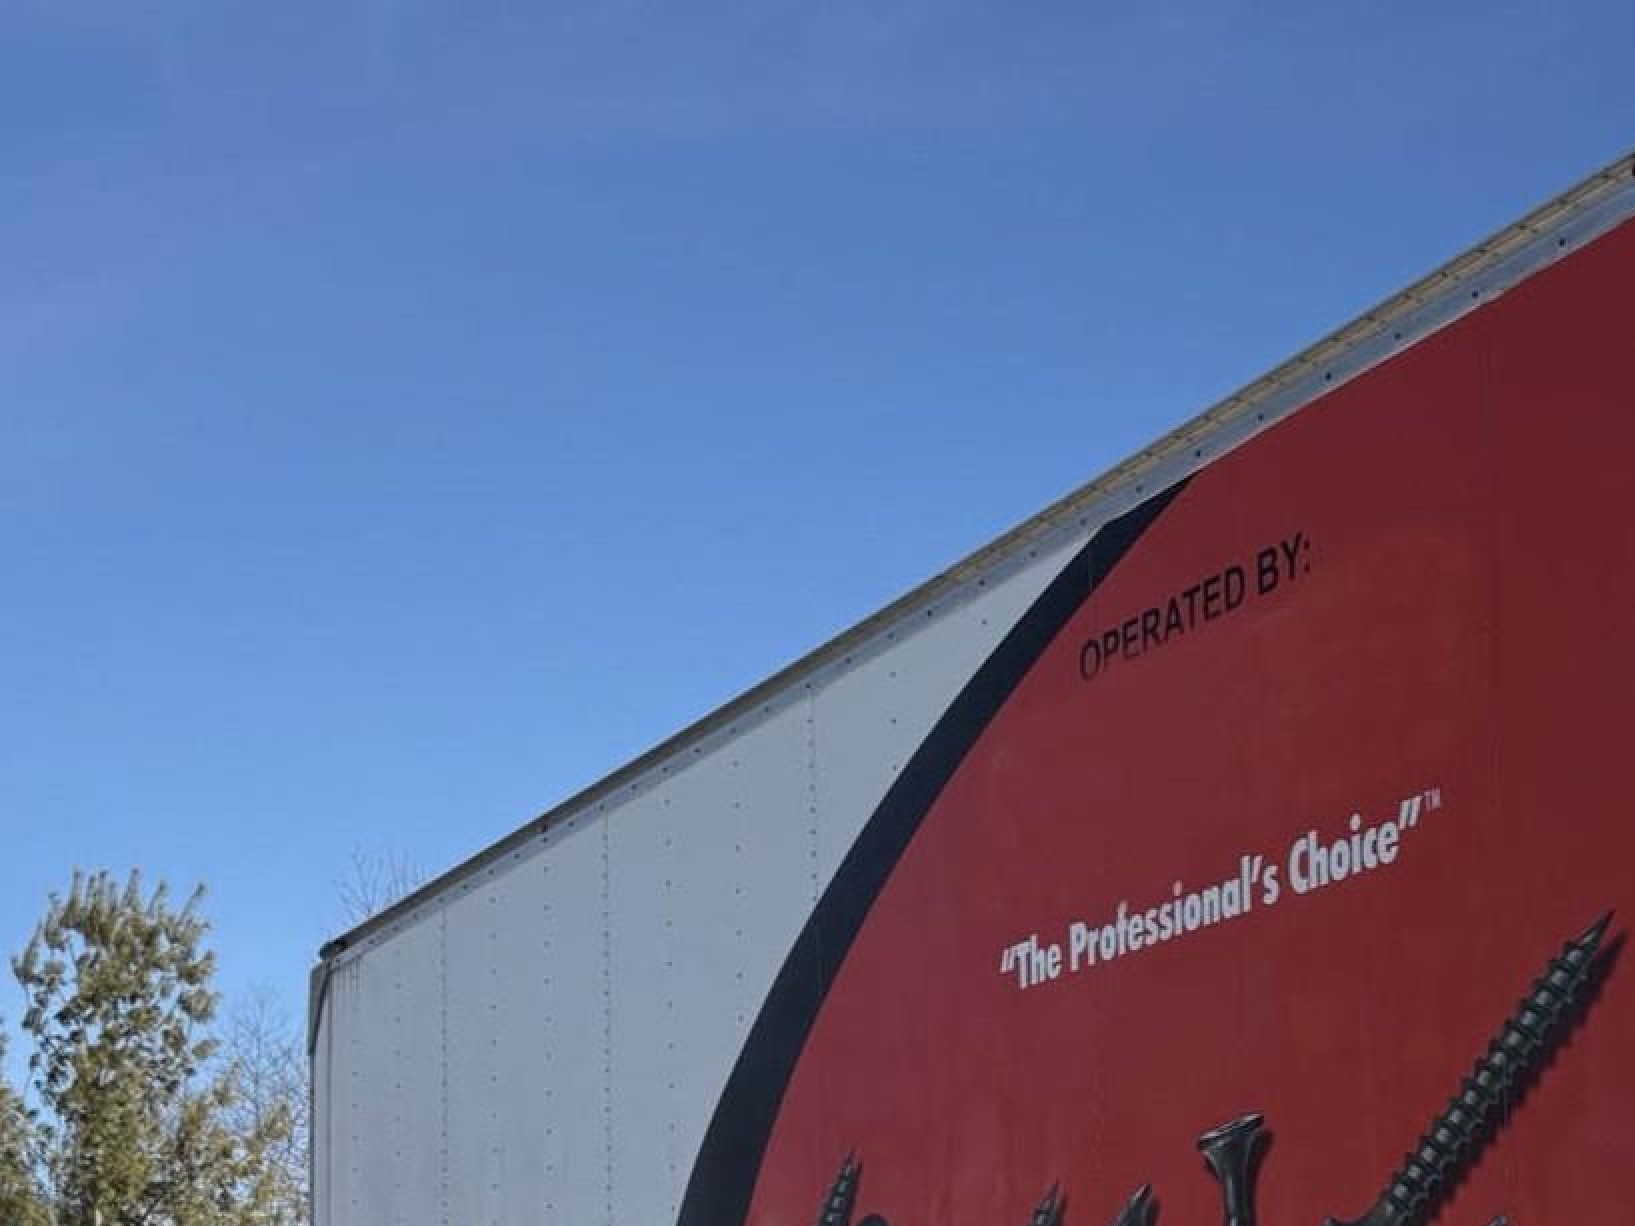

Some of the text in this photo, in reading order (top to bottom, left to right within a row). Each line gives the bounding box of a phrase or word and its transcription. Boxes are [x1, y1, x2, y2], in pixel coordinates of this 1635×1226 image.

[1079, 531, 1311, 681] OPERATED BY:
[1070, 855, 1280, 971] Professional's
